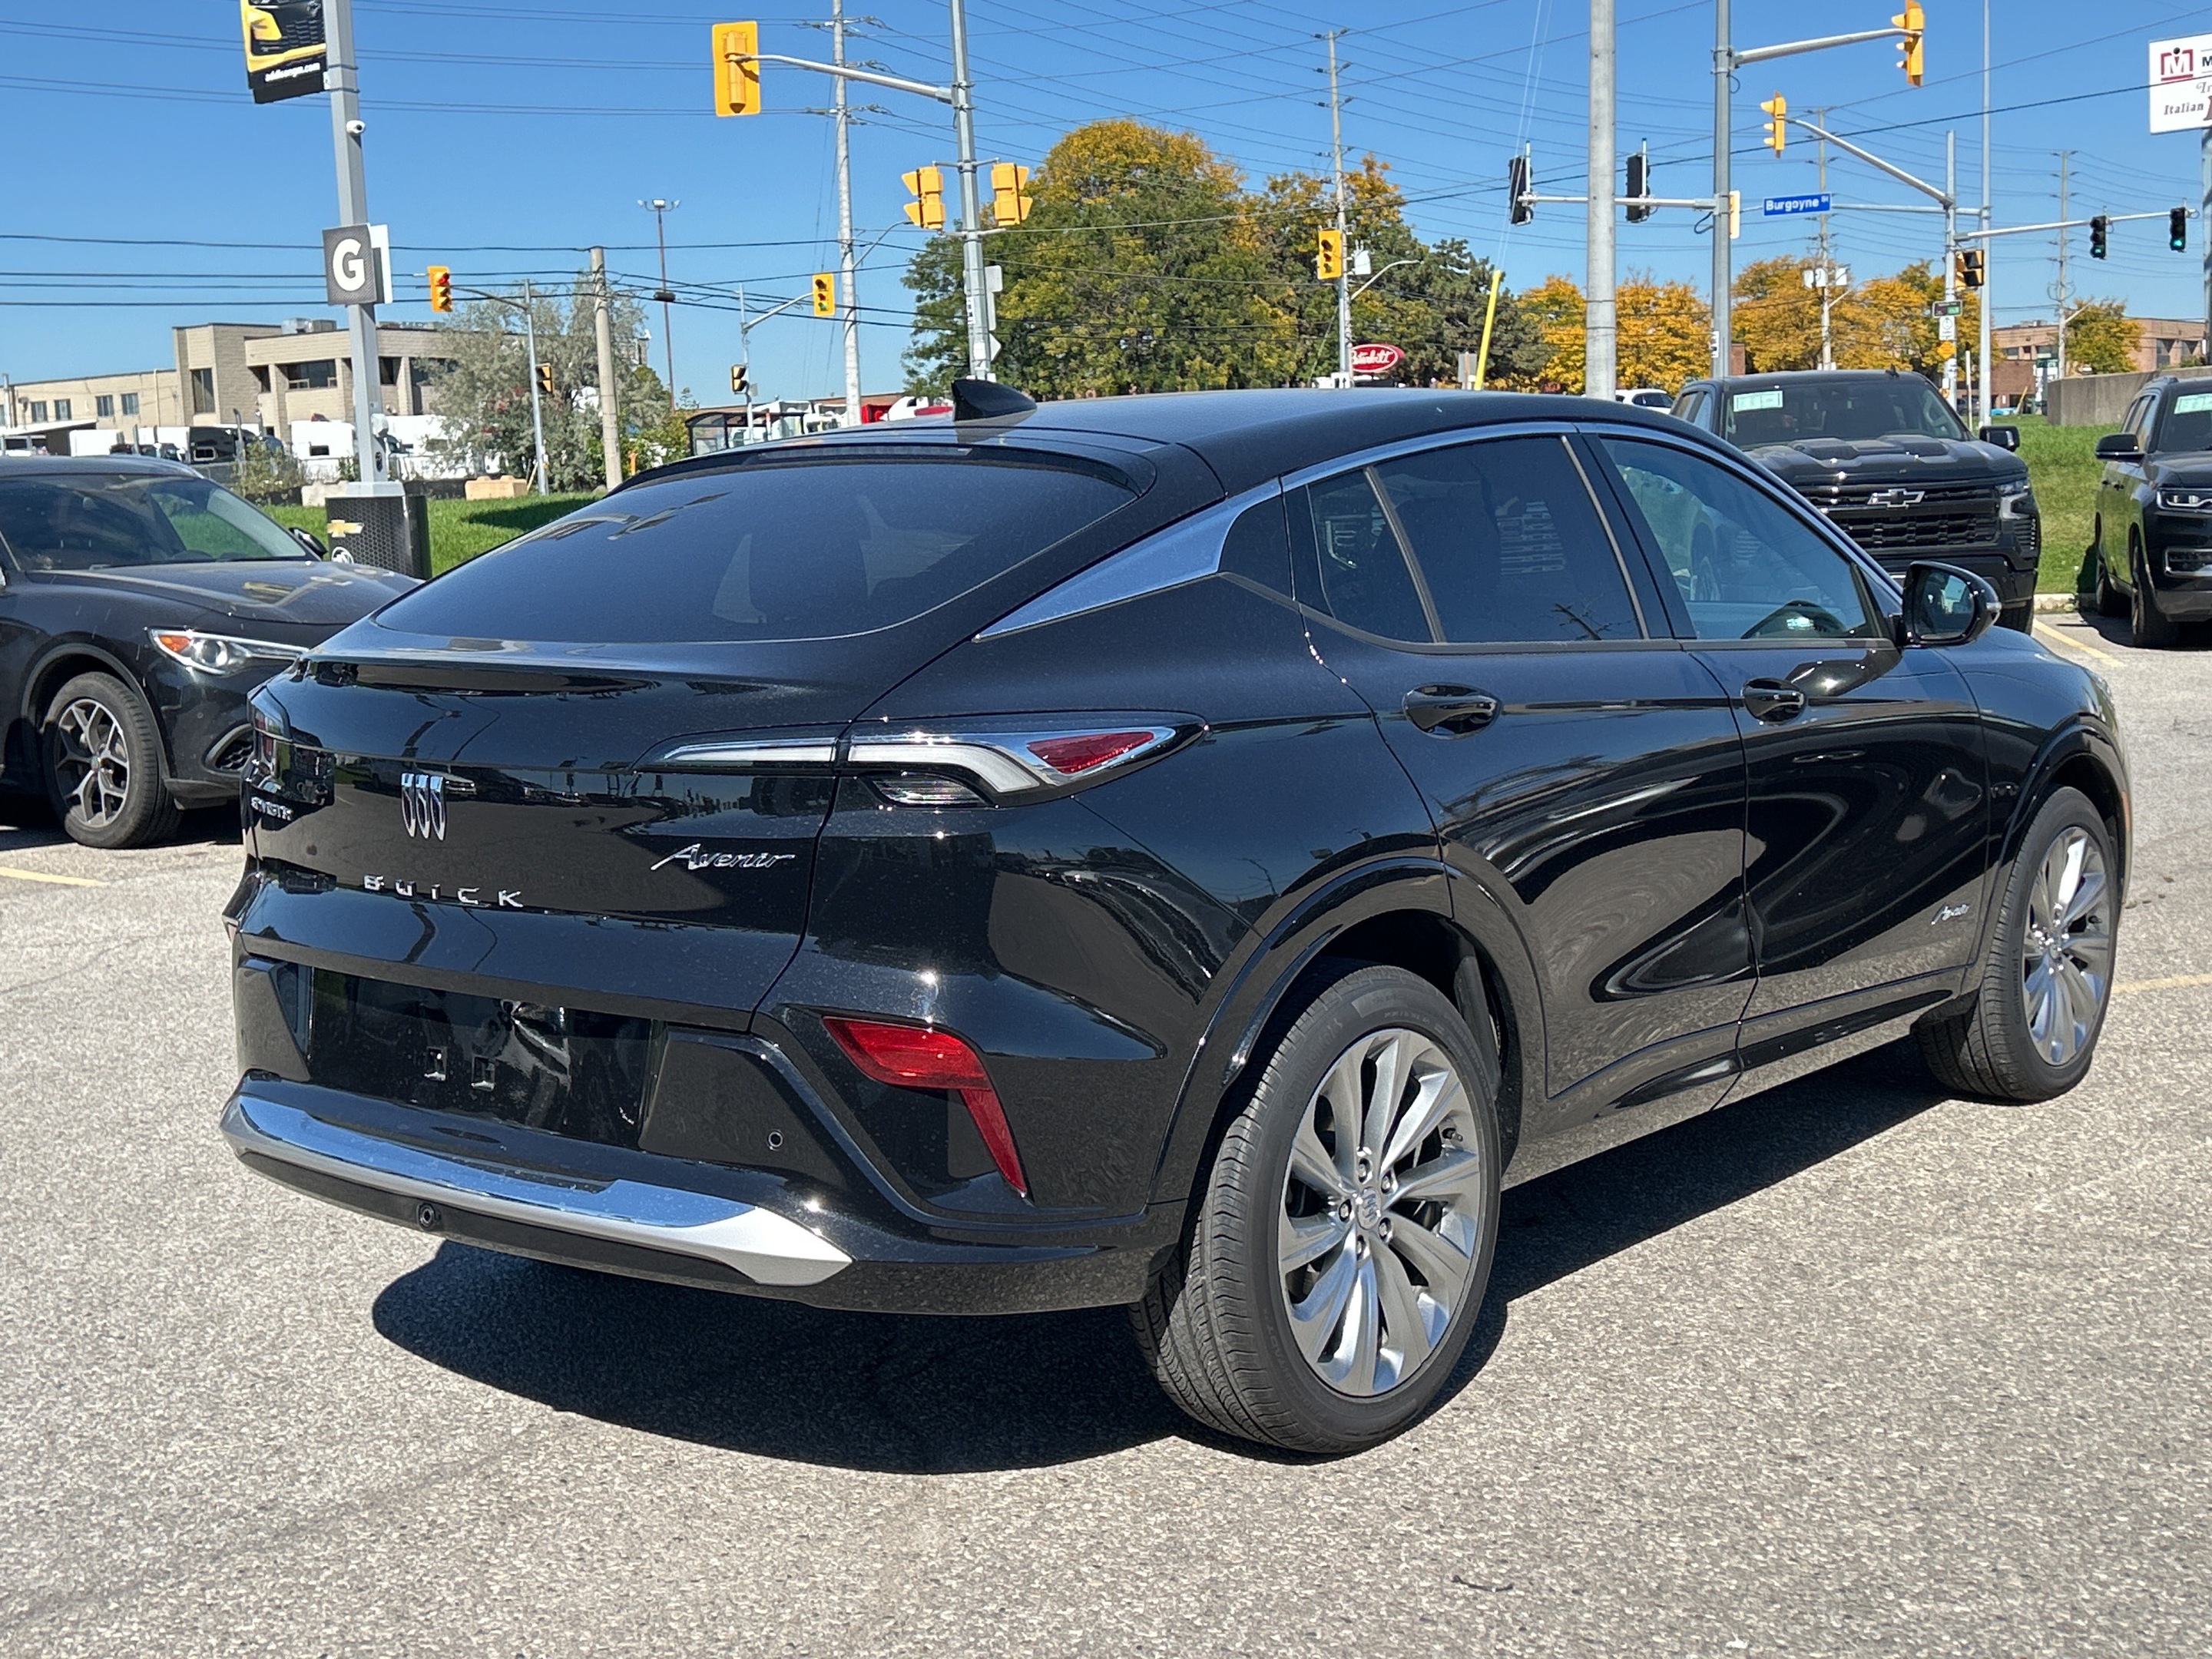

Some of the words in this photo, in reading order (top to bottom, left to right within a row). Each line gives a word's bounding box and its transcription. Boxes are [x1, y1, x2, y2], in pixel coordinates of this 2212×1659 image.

[2164, 103, 2204, 115] Italian
[1766, 198, 1820, 212] Burgoyne
[333, 238, 366, 292] G
[651, 843, 796, 871] Avenir
[363, 874, 524, 908] BUICK
